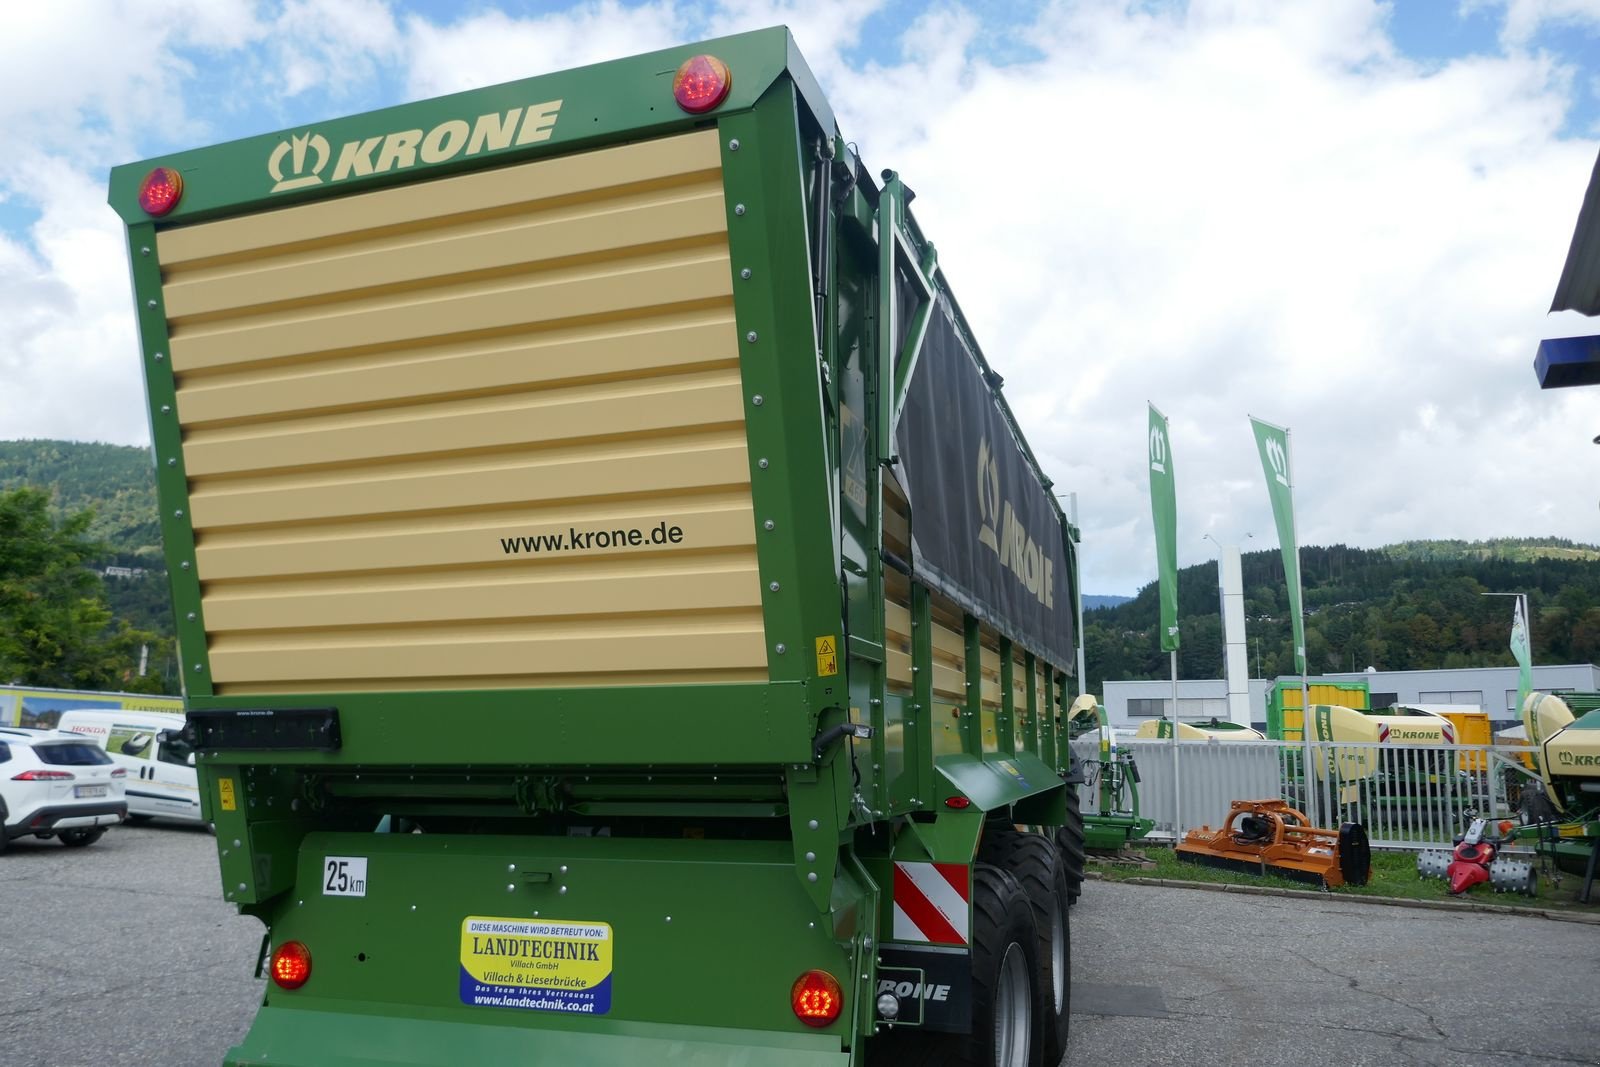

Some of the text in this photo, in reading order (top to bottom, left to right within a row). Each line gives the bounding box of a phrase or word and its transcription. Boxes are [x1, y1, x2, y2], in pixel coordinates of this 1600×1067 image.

[332, 99, 563, 182] KRONE
[500, 521, 683, 554] www.krone.de
[72, 725, 107, 734] HONDA
[1402, 731, 1440, 740] KRONE
[471, 922, 603, 937] DIESE MASCHINE WIRD BETREUT VON:
[473, 937, 600, 961] LANDTECHNIK
[510, 960, 559, 970] Villach GmbH
[483, 971, 587, 988] Villach & Lieserbrücke
[494, 986, 515, 994] Team
[519, 988, 541, 996] Ihres
[546, 989, 595, 999] Vertrauens
[474, 995, 595, 1013] www.landtechnik.co.at
